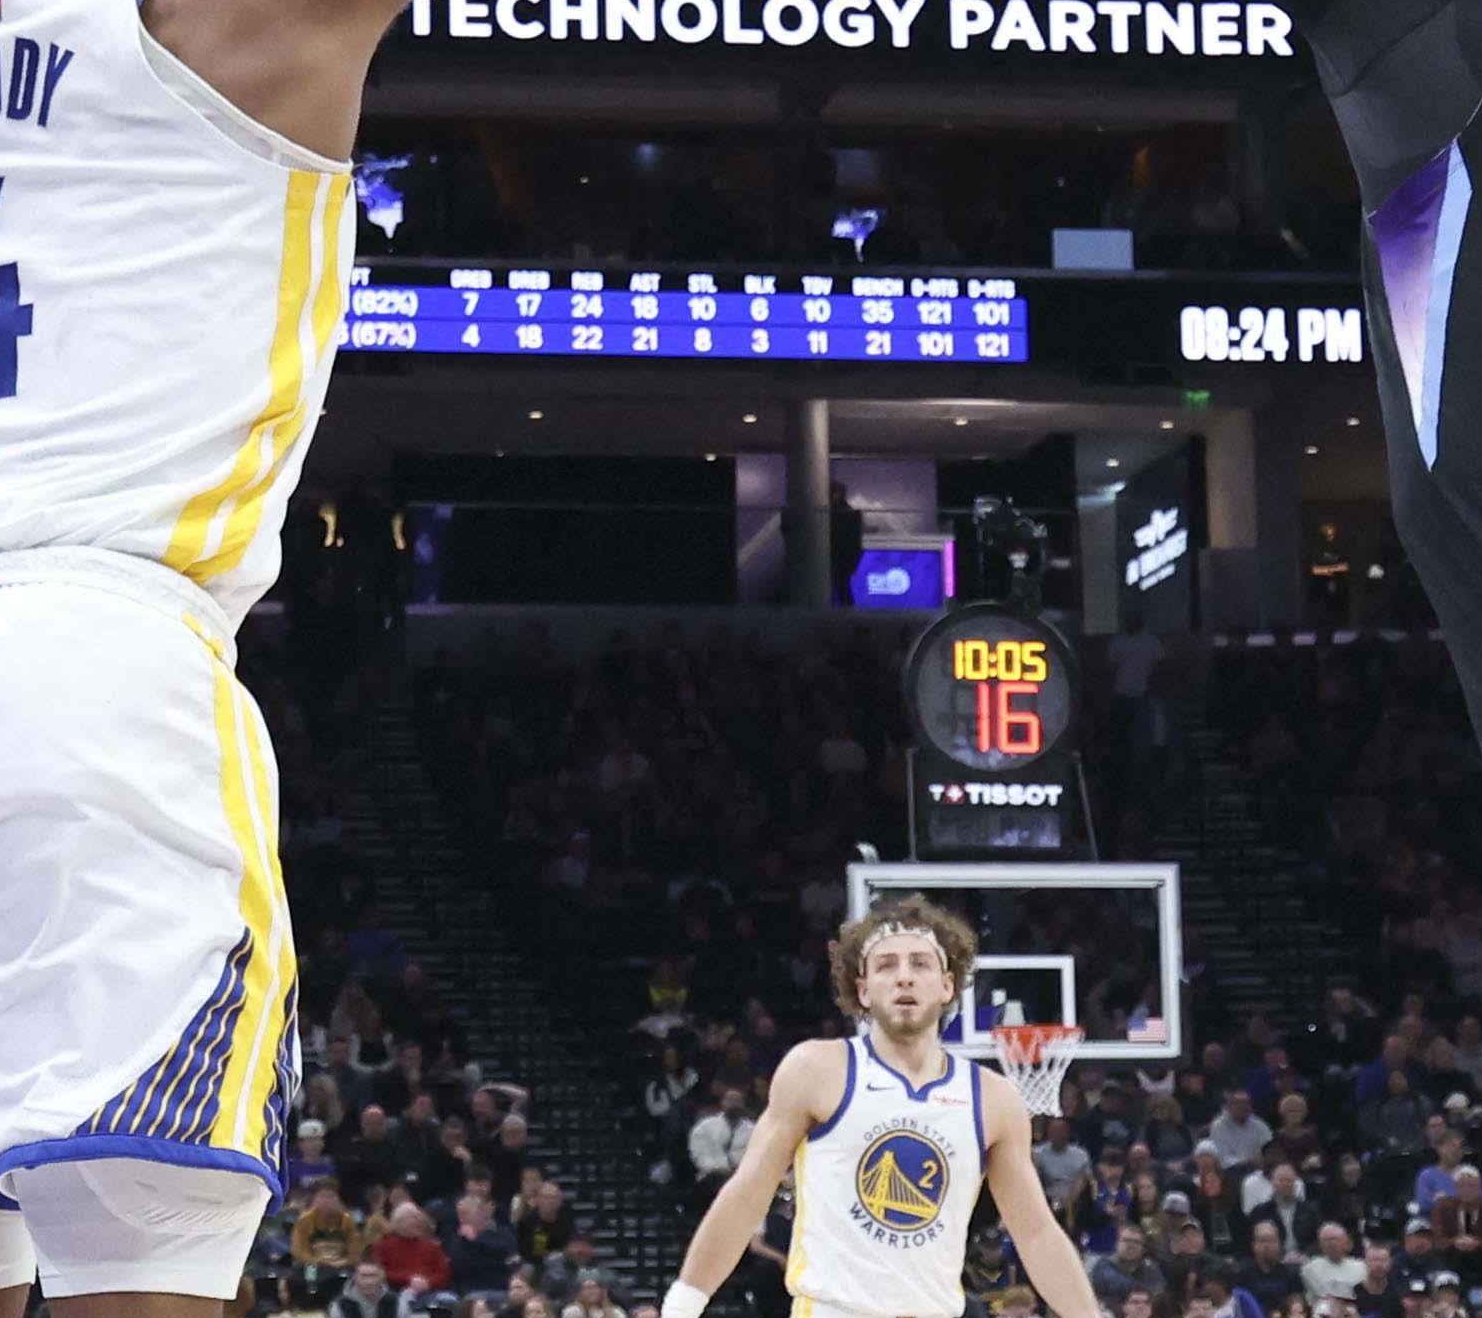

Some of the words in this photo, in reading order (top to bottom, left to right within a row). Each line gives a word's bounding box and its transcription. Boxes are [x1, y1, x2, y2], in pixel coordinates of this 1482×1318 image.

[628, 271, 663, 294] AST
[686, 272, 720, 296] STL
[462, 291, 480, 316] 7
[515, 292, 542, 317] 17
[570, 293, 604, 318] 24
[630, 295, 659, 320] 18
[688, 296, 717, 321] 10
[750, 297, 770, 322] 6
[802, 298, 832, 323] 10
[861, 299, 895, 324] 35
[917, 300, 952, 325] 121
[972, 301, 1010, 326] 101
[461, 323, 481, 348] 4
[515, 324, 544, 349] 18
[572, 325, 603, 350] 22
[632, 326, 658, 351] 21
[693, 327, 713, 352] 8
[751, 328, 770, 353] 3
[807, 330, 828, 354] 11
[865, 330, 892, 356] 21
[917, 331, 954, 356] 101
[975, 332, 1010, 358] 121
[1180, 306, 1290, 362] 08:24
[1297, 308, 1362, 362] PM
[954, 640, 1049, 683] 10:05
[974, 681, 1042, 755] 16
[964, 783, 1064, 807] TISSOT
[863, 1116, 919, 1143] GOLDEN
[923, 1124, 958, 1159] STATE
[919, 1159, 938, 1190] 2
[848, 1200, 946, 1250] WARRIORS
